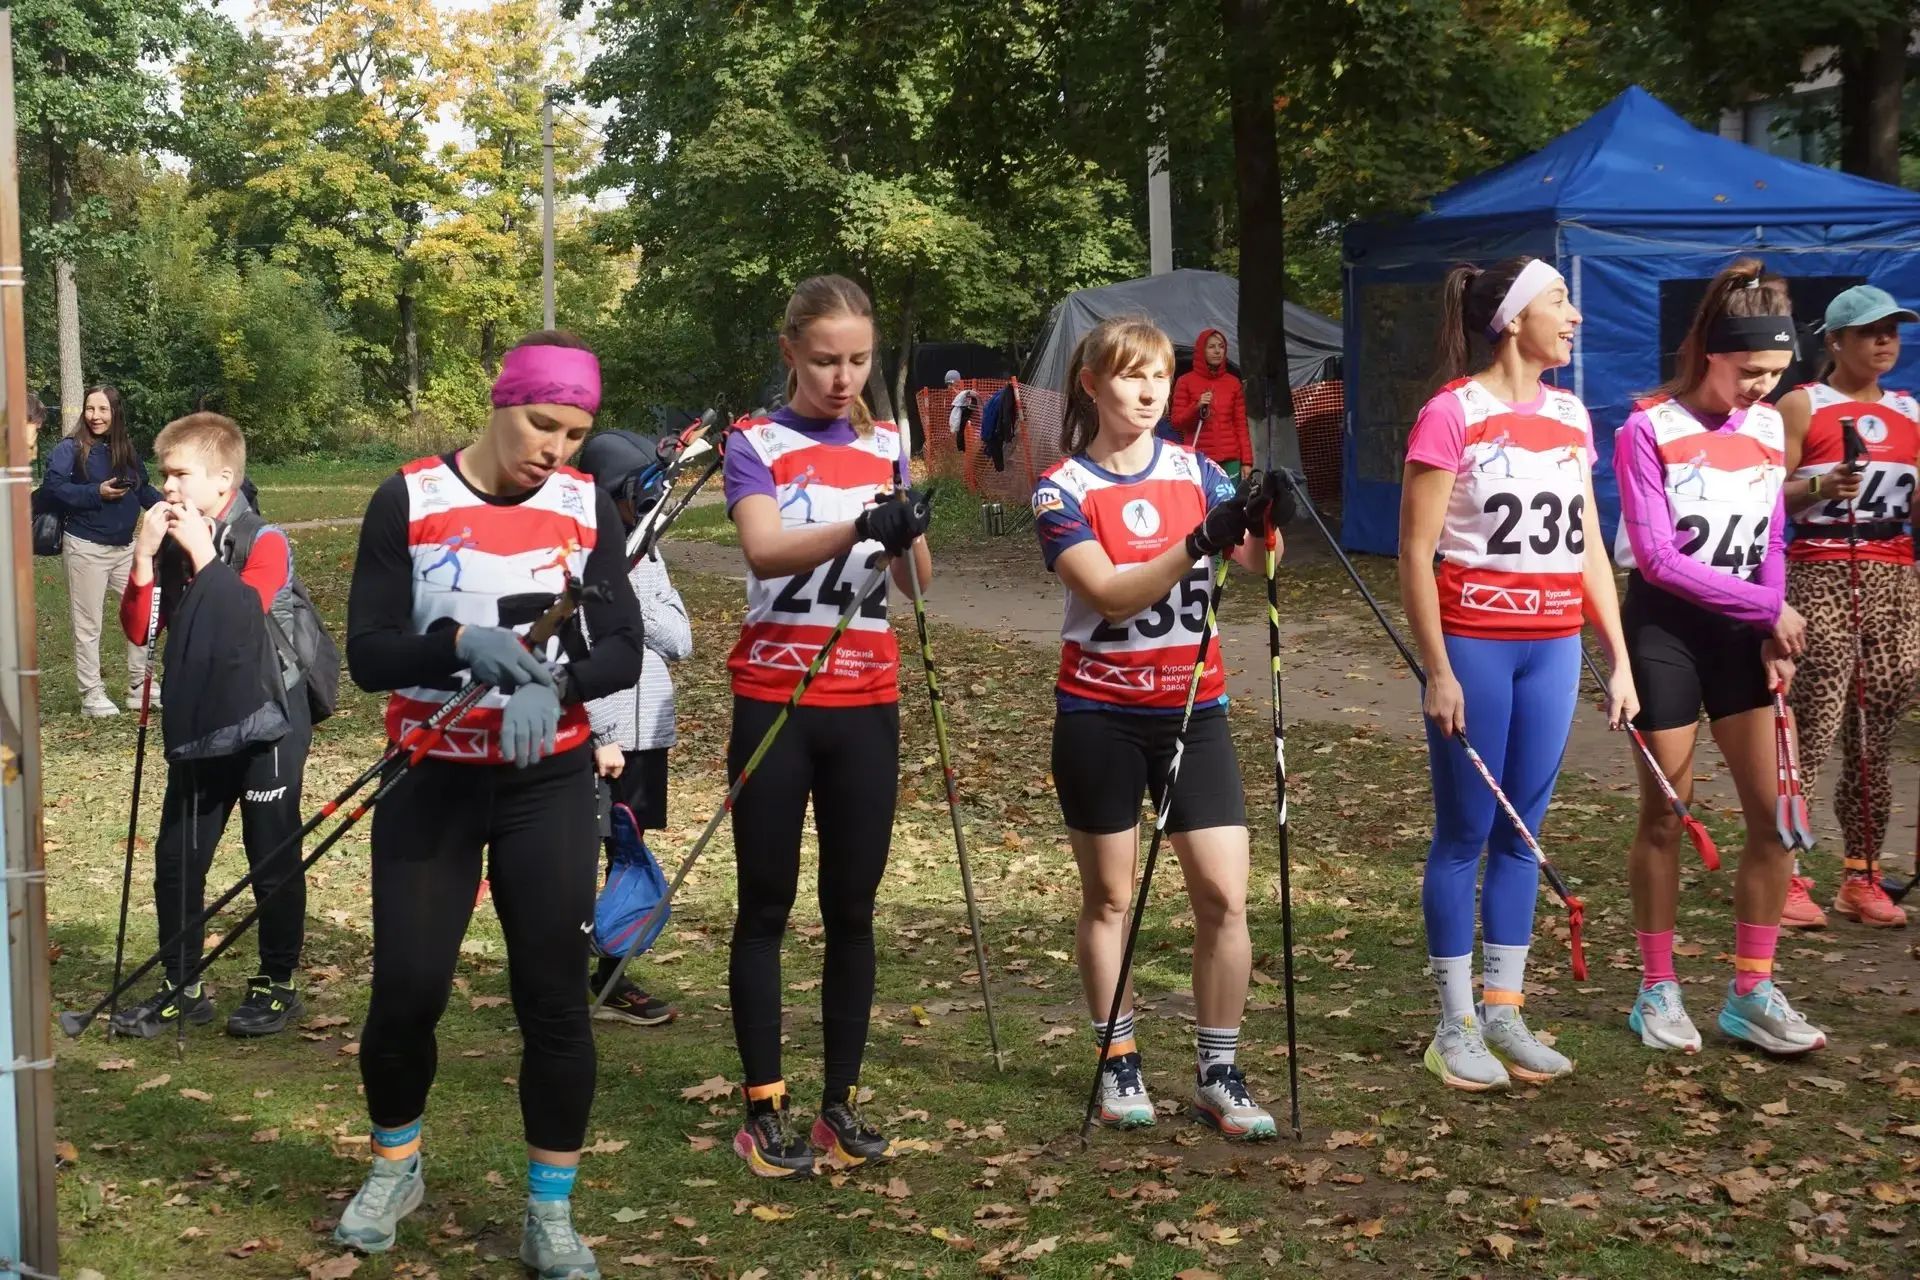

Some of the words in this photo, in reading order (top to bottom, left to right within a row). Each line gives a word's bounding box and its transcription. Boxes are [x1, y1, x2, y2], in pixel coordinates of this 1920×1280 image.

[1483, 491, 1585, 555] 238
[836, 647, 874, 659] Курский
[1161, 683, 1187, 692] завод
[244, 785, 288, 803] SHIFT
